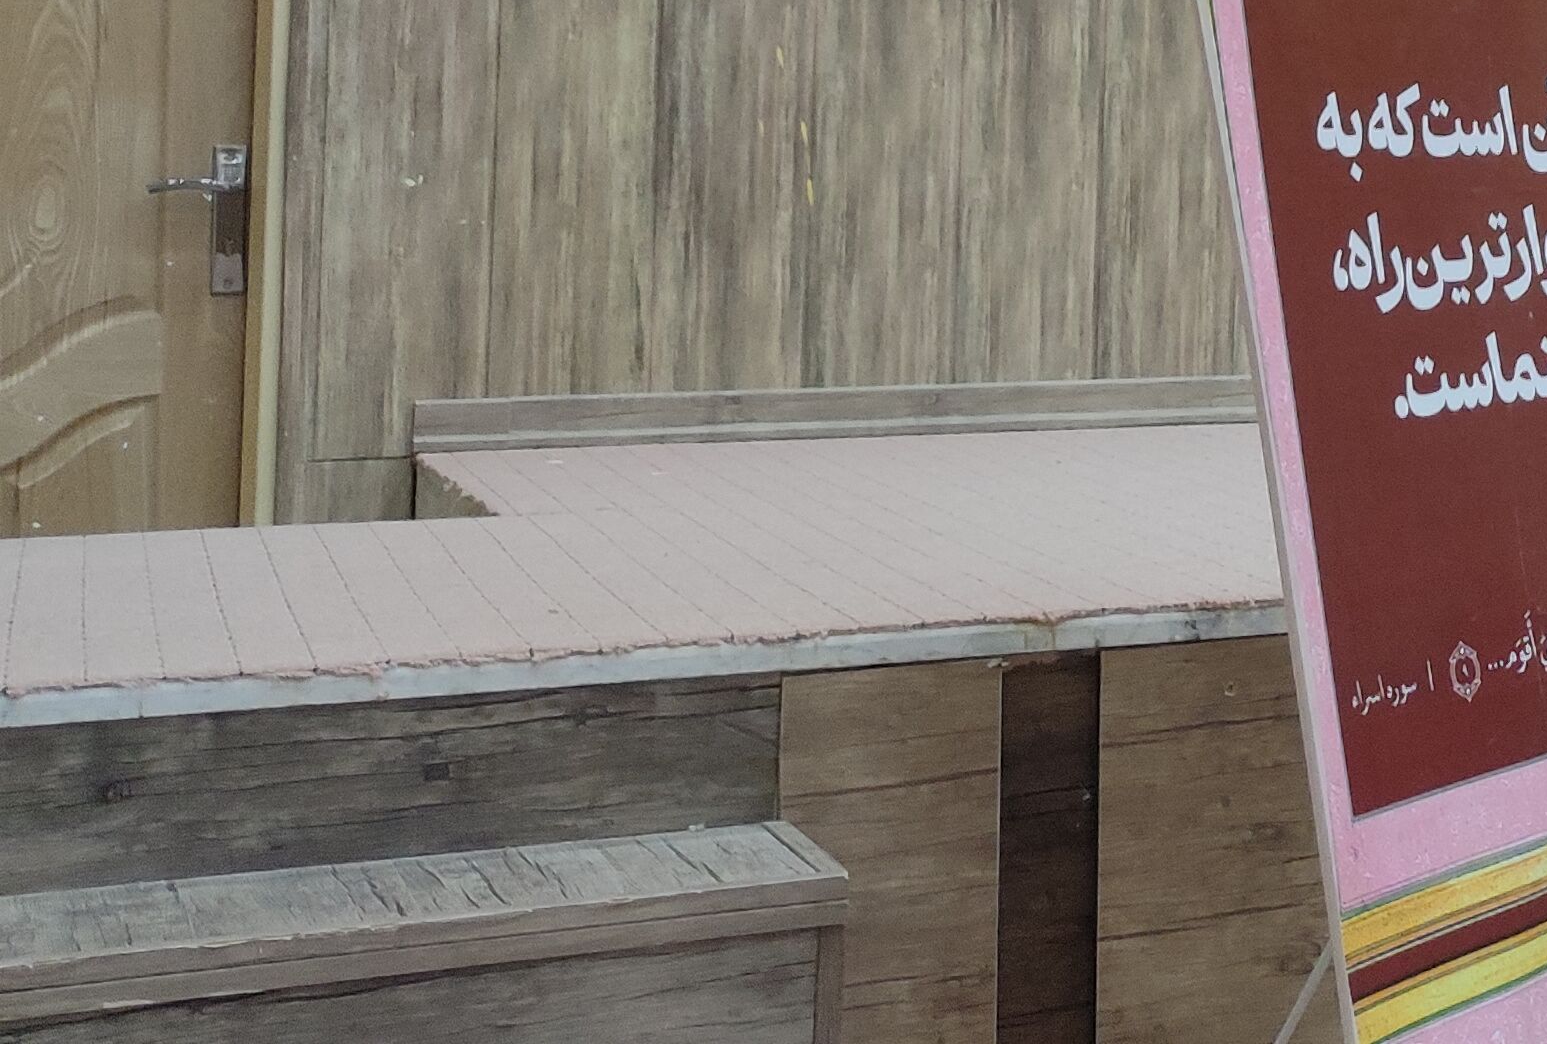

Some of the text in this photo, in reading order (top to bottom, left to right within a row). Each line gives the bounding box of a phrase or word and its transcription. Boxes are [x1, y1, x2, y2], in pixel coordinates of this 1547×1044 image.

[1316, 90, 1364, 181] به
[1368, 83, 1421, 157] که
[1422, 85, 1517, 156] است
[1386, 682, 1418, 708] سوره
